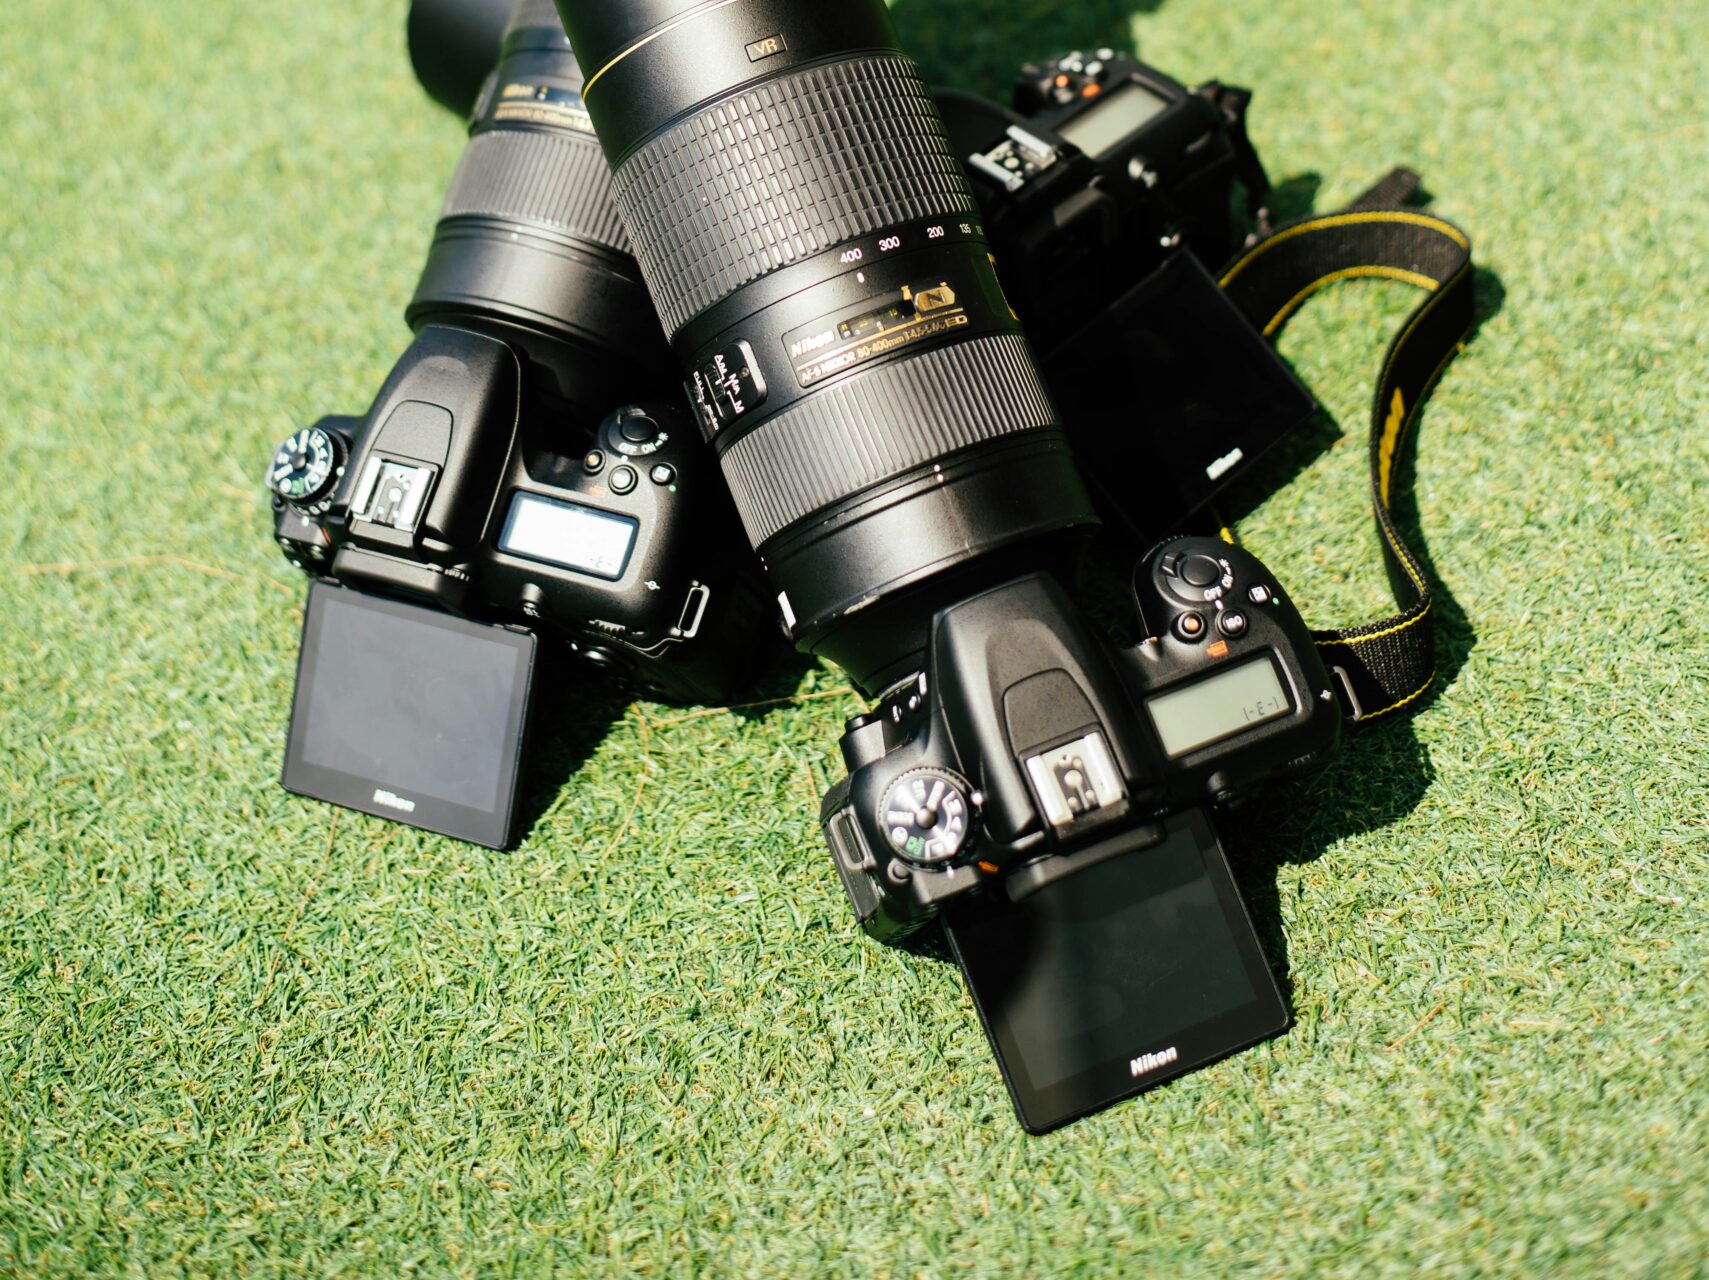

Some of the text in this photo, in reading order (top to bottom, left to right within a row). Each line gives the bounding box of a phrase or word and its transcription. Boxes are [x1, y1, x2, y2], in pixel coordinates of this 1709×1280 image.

[753, 38, 778, 55] VR
[840, 247, 863, 263] 400
[879, 235, 900, 251] 300
[926, 225, 944, 238] 200
[959, 223, 972, 234] 135
[790, 330, 835, 358] Nikon
[1203, 573, 1234, 601] OFF ON
[1224, 615, 1244, 630] ISO
[1130, 1046, 1178, 1077] Nikon
